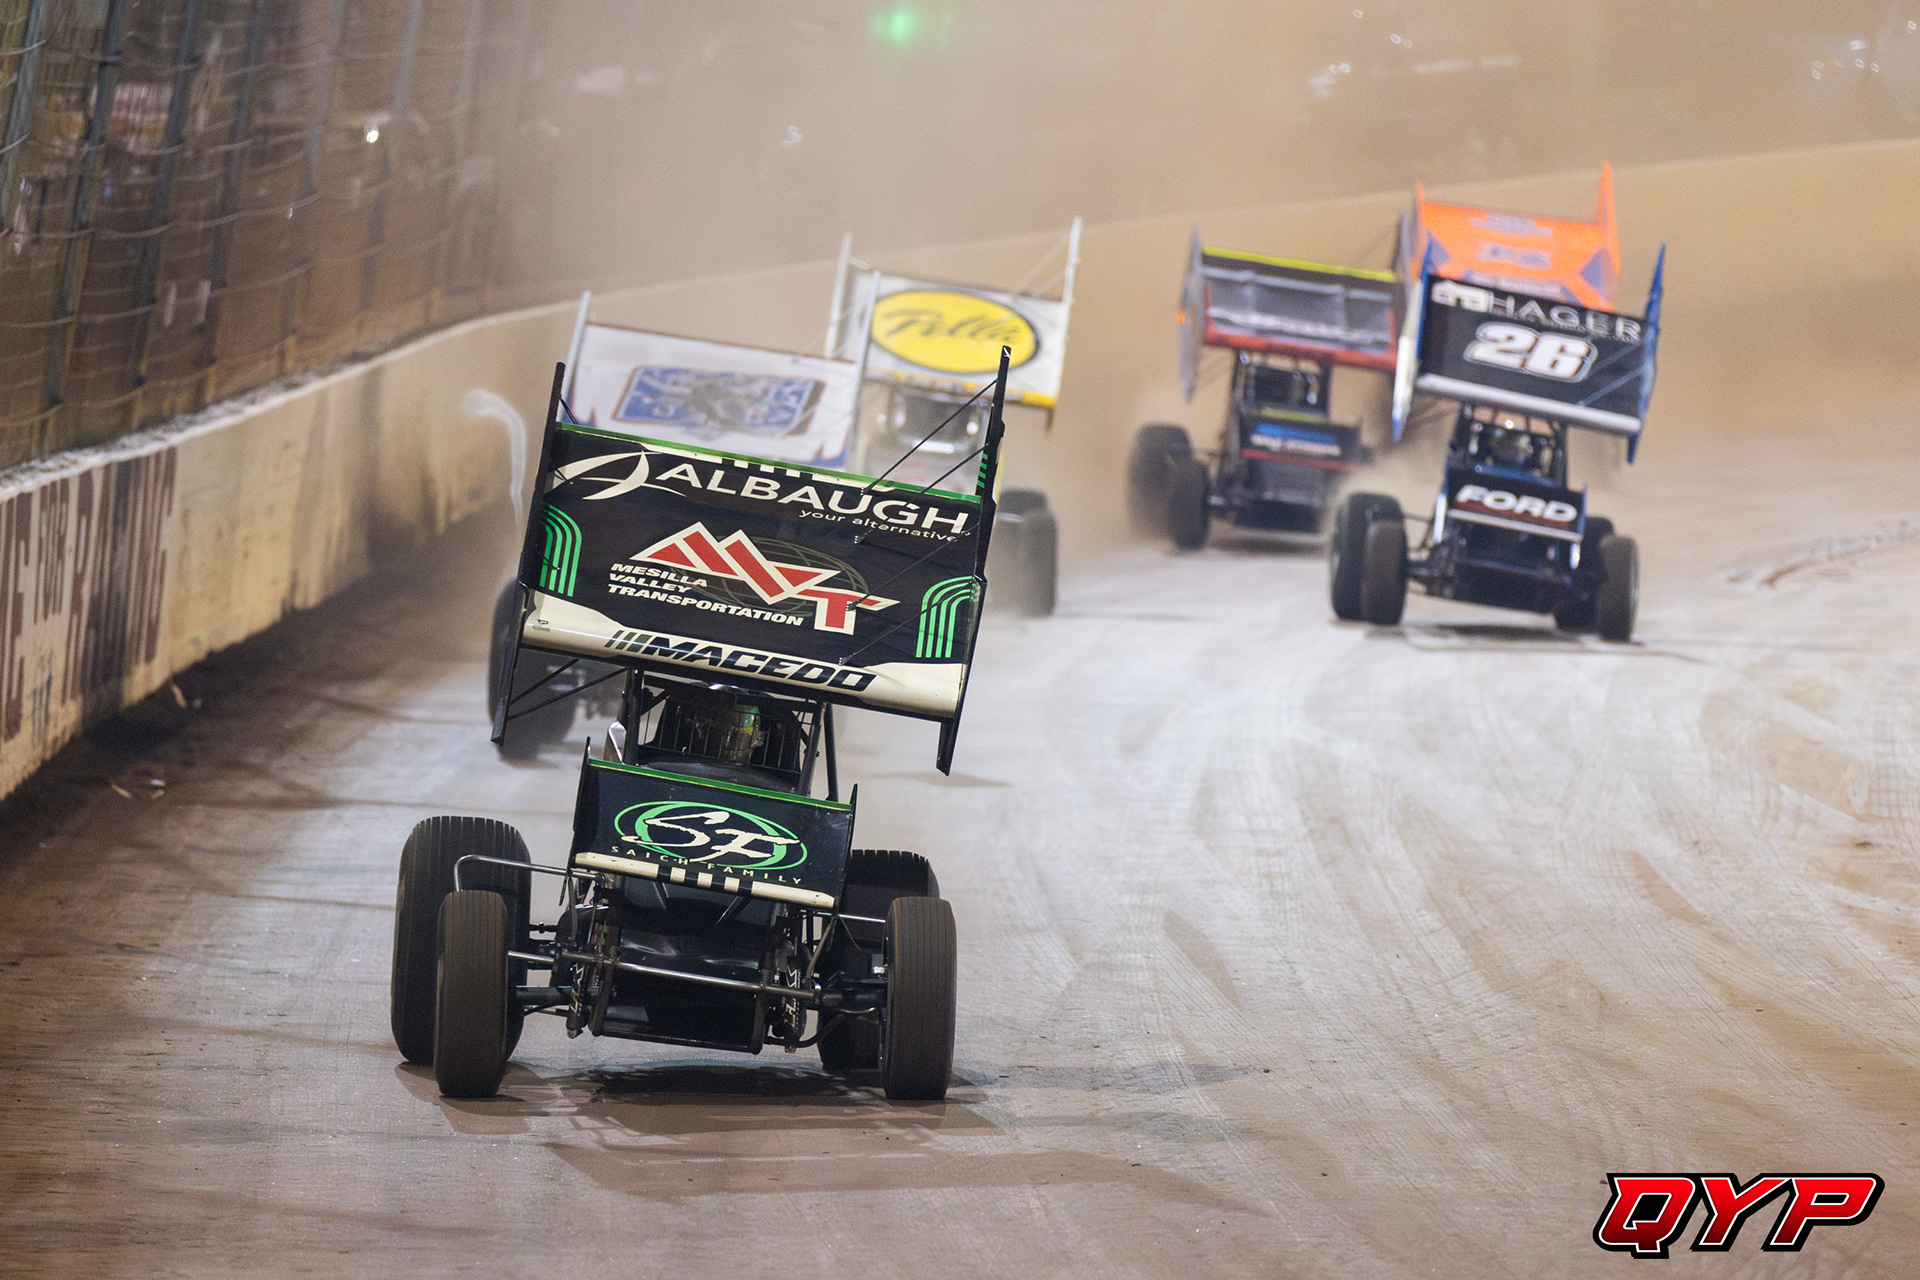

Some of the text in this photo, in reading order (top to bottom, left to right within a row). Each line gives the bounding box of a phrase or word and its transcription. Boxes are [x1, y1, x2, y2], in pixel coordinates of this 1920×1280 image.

[1490, 292, 1642, 341] HAGER
[1463, 322, 1598, 383] 26
[656, 462, 969, 535] ALBAUGH
[799, 509, 845, 522] your
[1457, 484, 1578, 522] FORD
[608, 572, 693, 593] VALLEY
[610, 562, 708, 588] MESILLA
[607, 582, 804, 627] TRANSPORTATION
[642, 635, 877, 691] MACEDO
[611, 845, 803, 885] SAICH FAMILY
